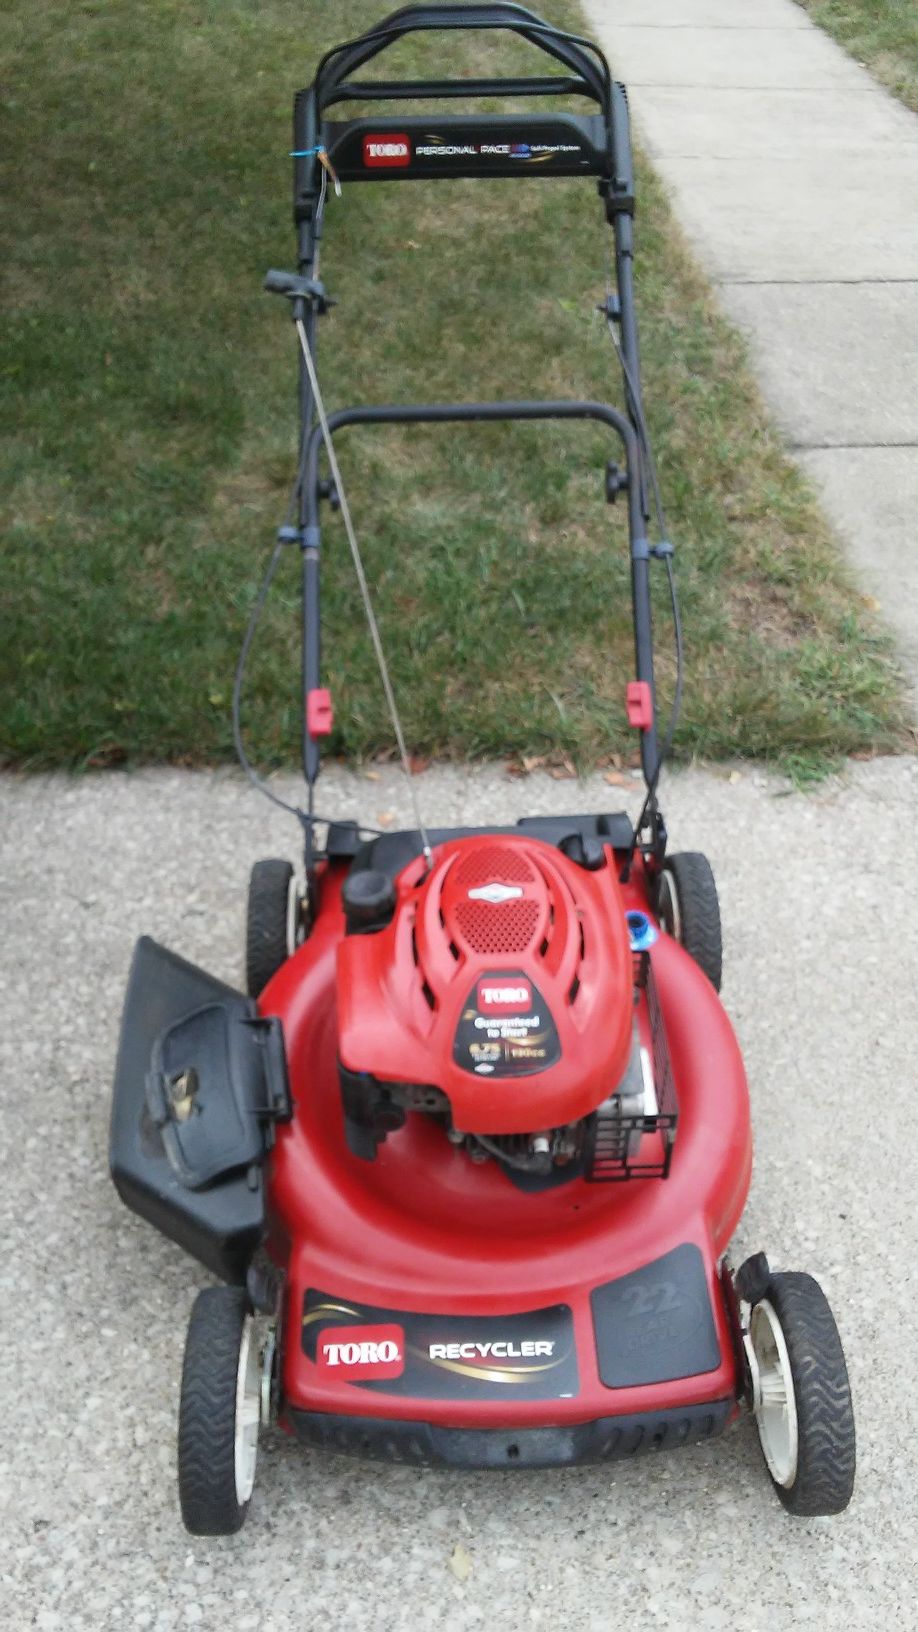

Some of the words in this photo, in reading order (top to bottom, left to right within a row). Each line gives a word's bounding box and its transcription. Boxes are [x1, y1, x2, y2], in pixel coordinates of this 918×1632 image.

[366, 143, 408, 157] TORO
[415, 145, 478, 155] PERSONAL
[480, 144, 510, 153] PACE
[481, 988, 528, 1004] TORO
[474, 1016, 540, 1029] Guaranteed
[487, 1028, 500, 1038] to
[500, 1027, 528, 1038] Start
[621, 1281, 683, 1318] 22
[323, 1341, 400, 1367] TORO
[429, 1341, 554, 1361] RECYCLER
